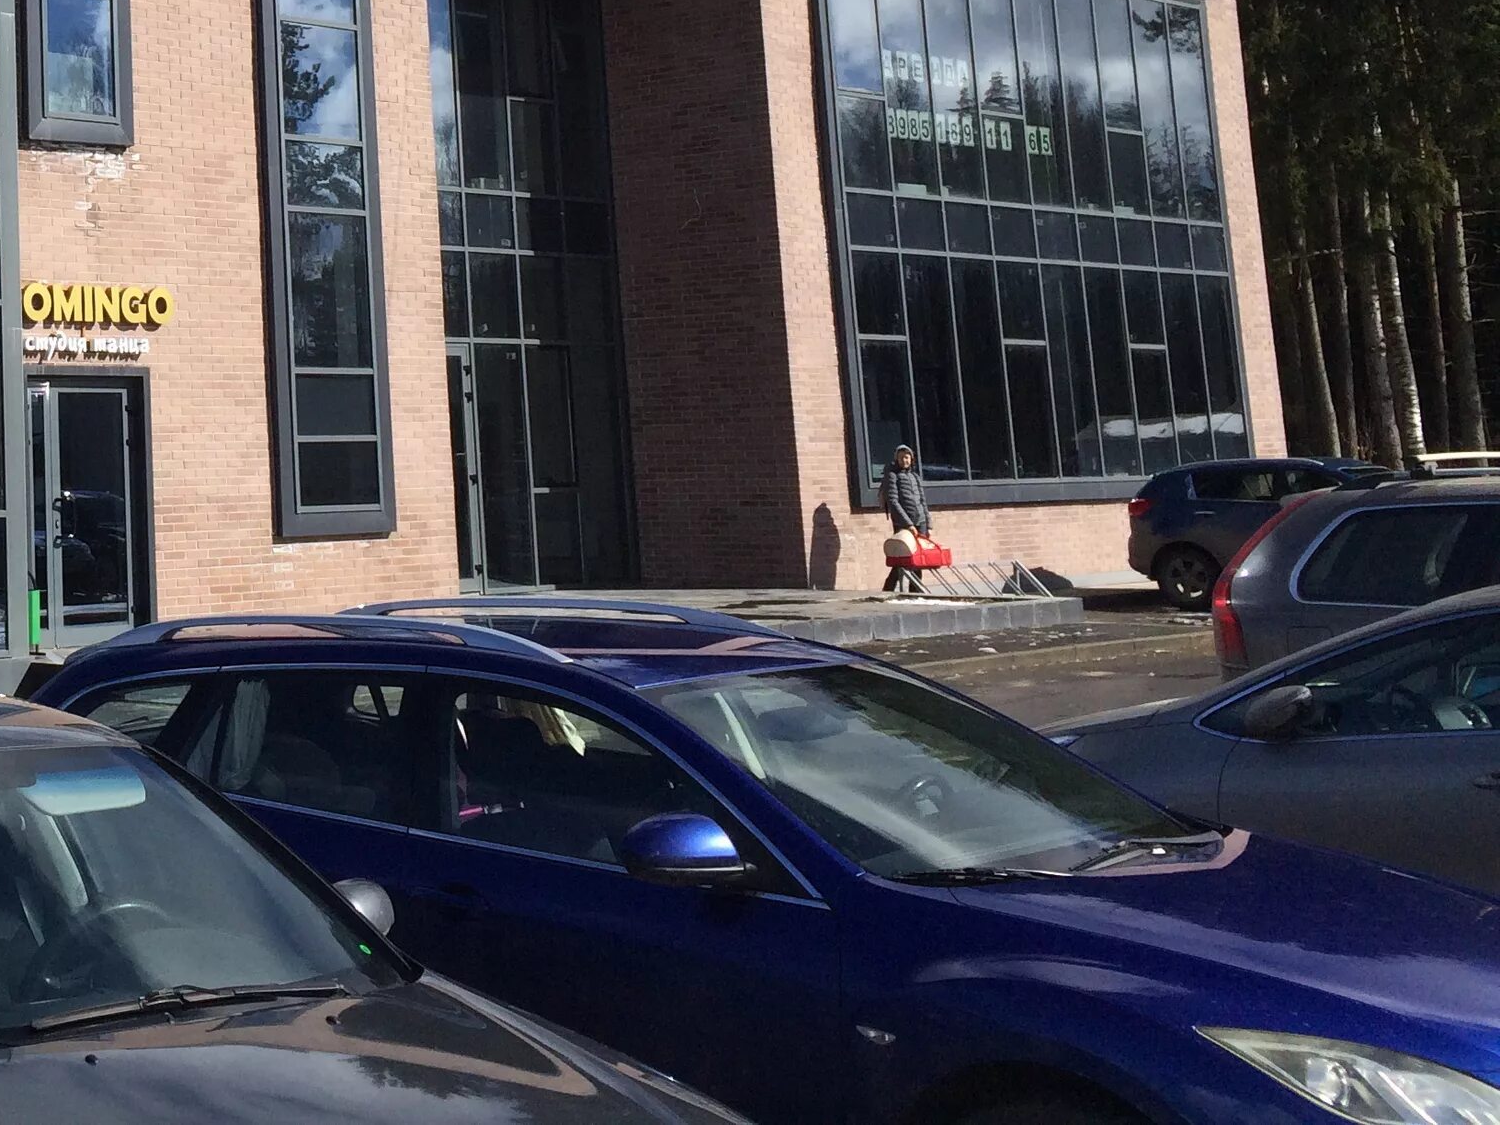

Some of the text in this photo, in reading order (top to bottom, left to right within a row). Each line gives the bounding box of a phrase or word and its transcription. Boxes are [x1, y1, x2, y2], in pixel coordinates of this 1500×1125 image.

[23, 282, 174, 325] OMINGO
[25, 330, 150, 360] студия танца
